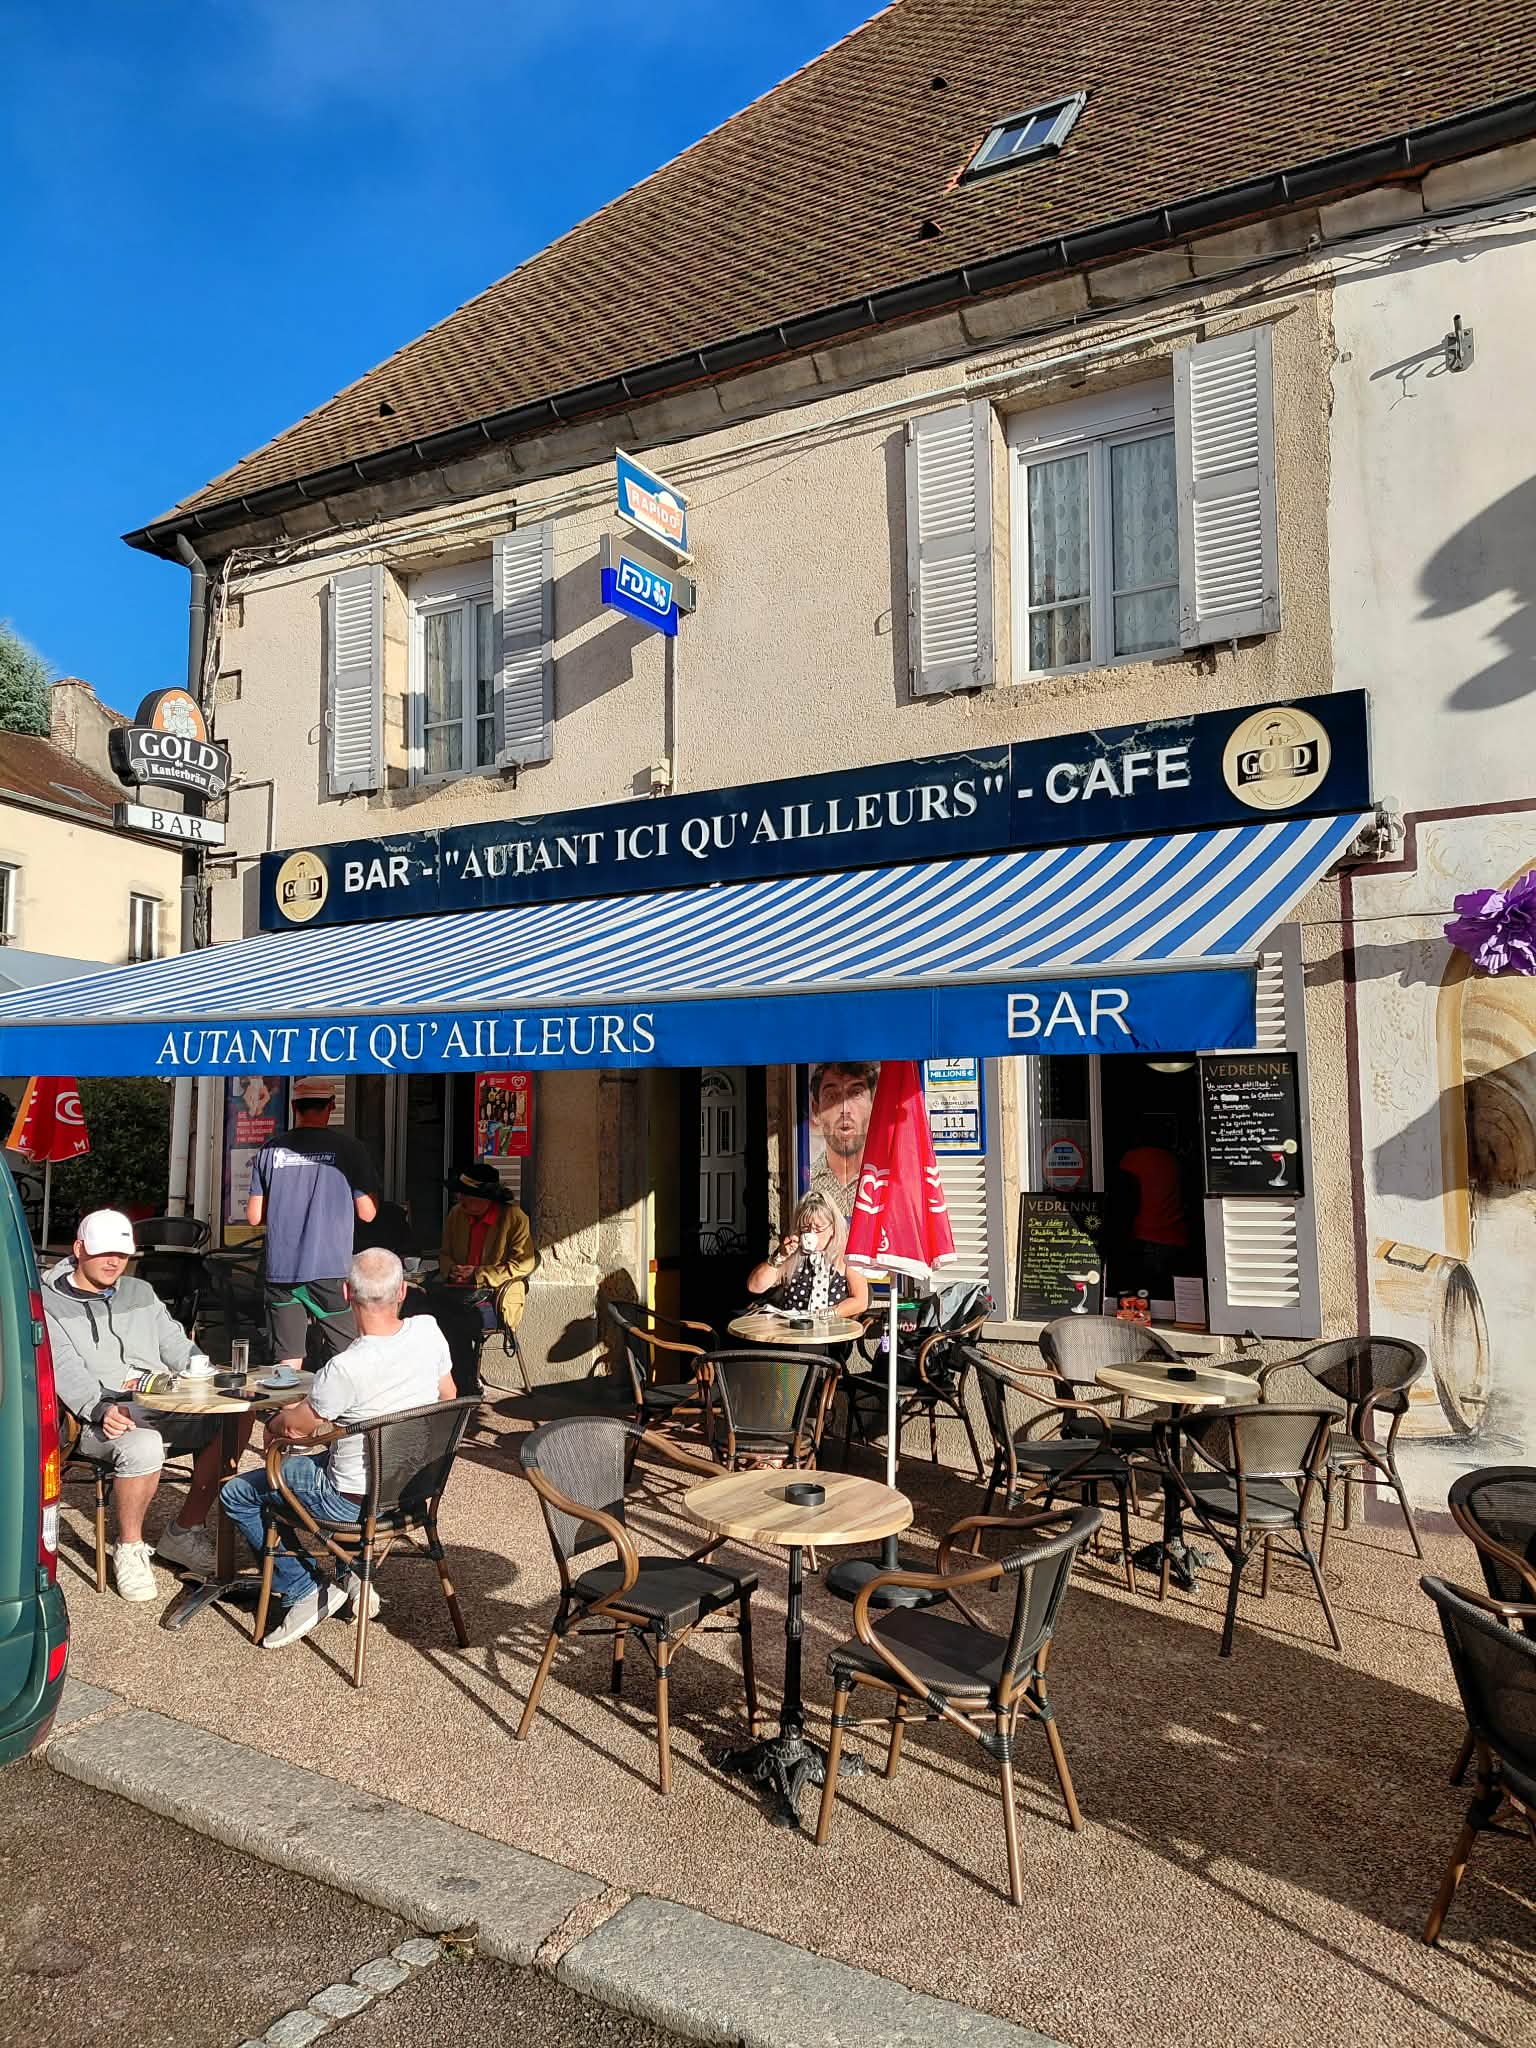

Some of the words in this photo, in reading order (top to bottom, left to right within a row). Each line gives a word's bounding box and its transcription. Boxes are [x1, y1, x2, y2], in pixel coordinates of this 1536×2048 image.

[631, 491, 680, 529] RAPIDO
[620, 563, 651, 599] FDJ
[139, 732, 218, 770] GOLD
[175, 759, 183, 768] de
[1242, 746, 1312, 775] GOLD
[151, 763, 206, 786] Kanterbräu
[151, 811, 202, 838] BAR
[344, 856, 410, 892] BAR
[445, 832, 604, 880] "AUTANT
[615, 823, 669, 862] ICI
[1046, 745, 1191, 804] CAFE
[1007, 988, 1132, 1039] BAR
[155, 1028, 300, 1065] AUTANT
[307, 1026, 359, 1062] ICI
[930, 1070, 967, 1078] MILLIONS
[1208, 1062, 1290, 1077] VEDRENNE
[933, 1131, 969, 1139] MILLIONS
[943, 1116, 966, 1128] 111
[1028, 1200, 1097, 1213] VEDRENNE
